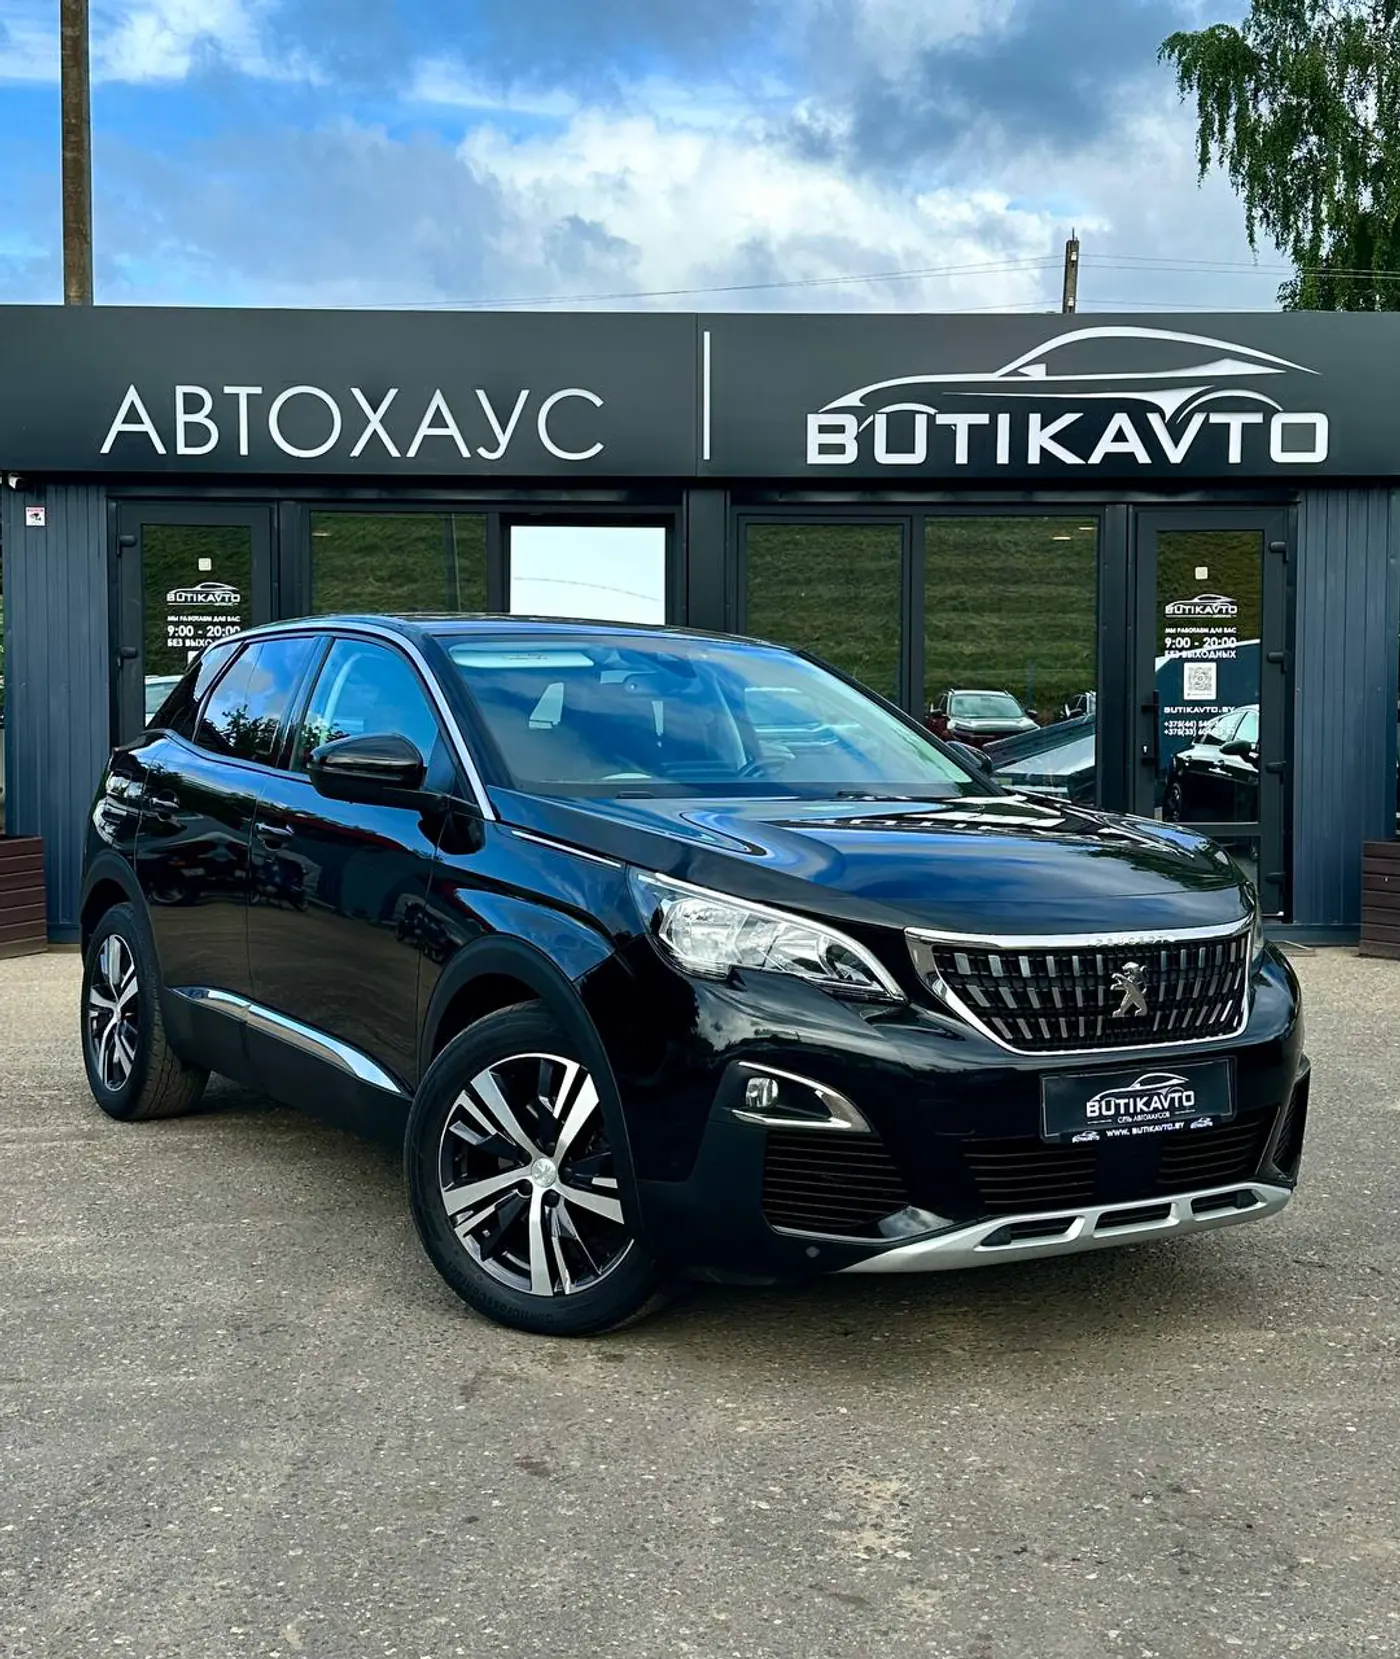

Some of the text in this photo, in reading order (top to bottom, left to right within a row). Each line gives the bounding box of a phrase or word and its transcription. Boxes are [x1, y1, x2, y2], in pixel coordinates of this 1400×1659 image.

[100, 383, 606, 461] АВТОХАУС
[806, 411, 1329, 465] BUTIKAVTO
[166, 592, 241, 602] BUTIKAVTO
[1165, 605, 1238, 614] BUTIKAVTO
[167, 625, 194, 637] 9:00
[167, 639, 182, 647] БЕЗ
[1165, 637, 1191, 648] 9:00
[1203, 637, 1237, 648] 20:00
[1182, 650, 1237, 659] ВЫХОДНЫХ
[1086, 1090, 1196, 1118] BUTIKAVTO
